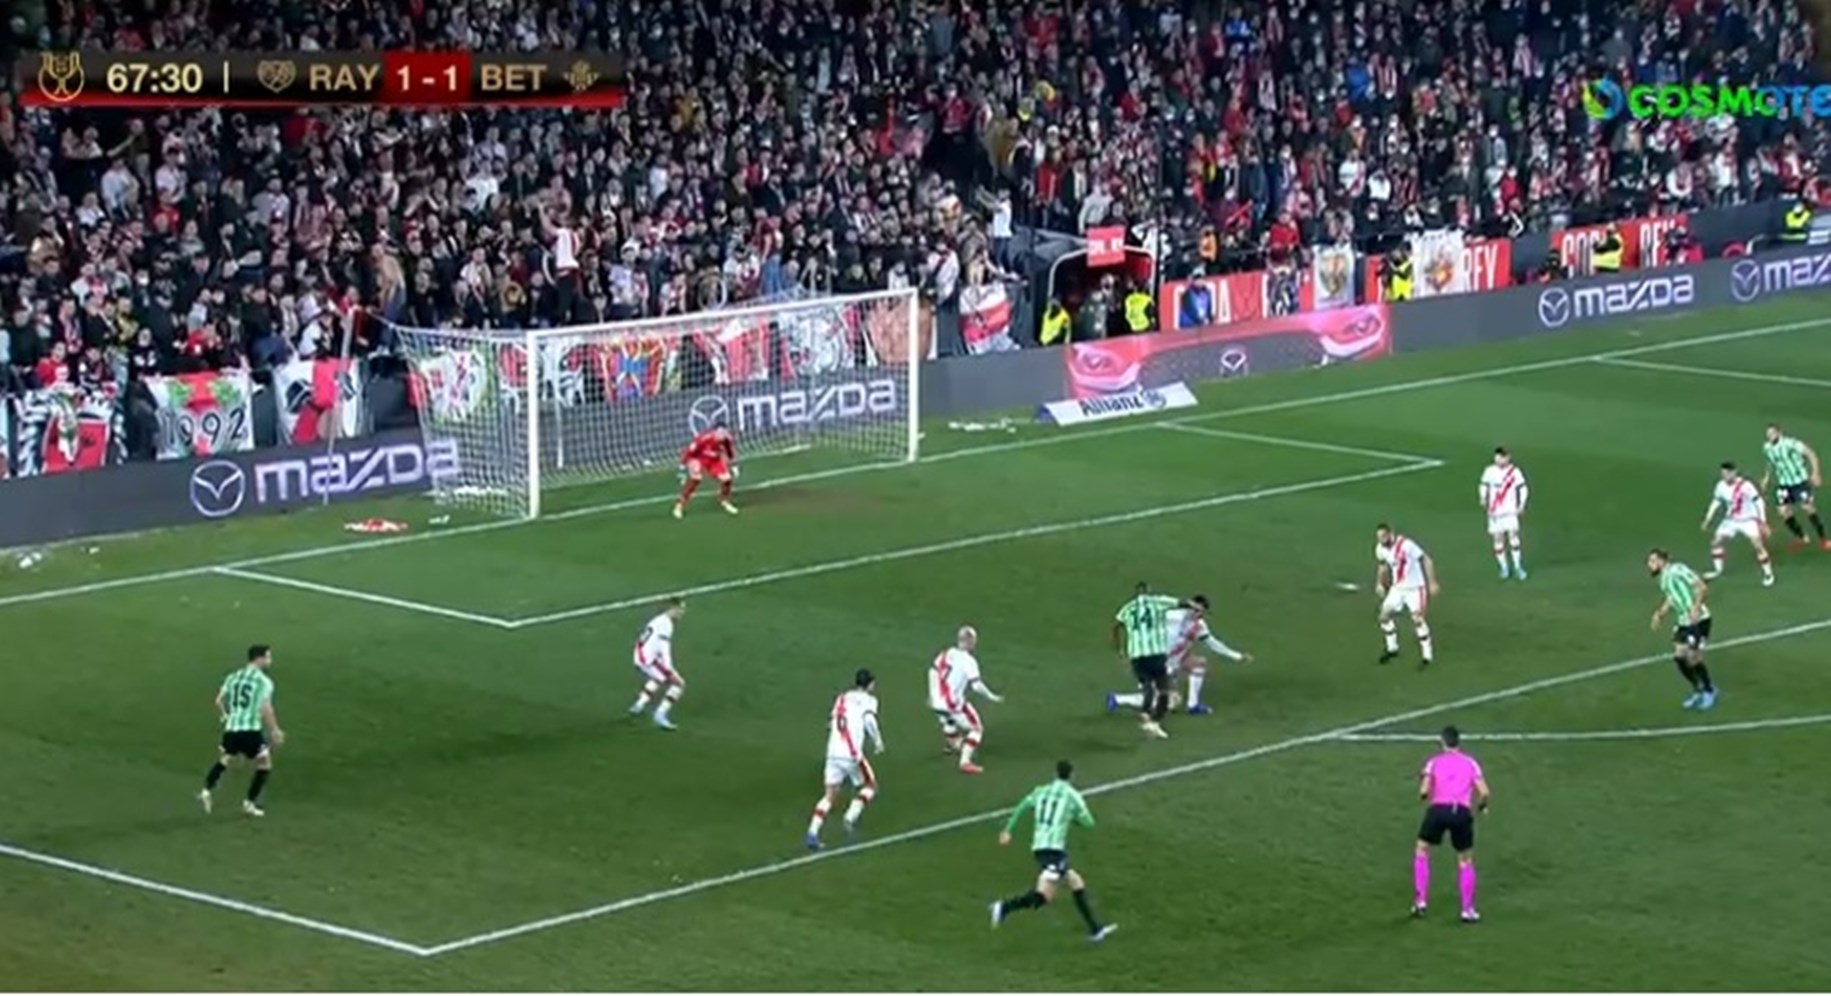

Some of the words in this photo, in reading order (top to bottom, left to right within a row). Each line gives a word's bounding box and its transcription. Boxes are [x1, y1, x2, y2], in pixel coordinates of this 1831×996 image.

[161, 406, 247, 447] 1992
[1130, 606, 1152, 630] 14
[231, 683, 253, 708] 15
[1039, 798, 1059, 826] 11
